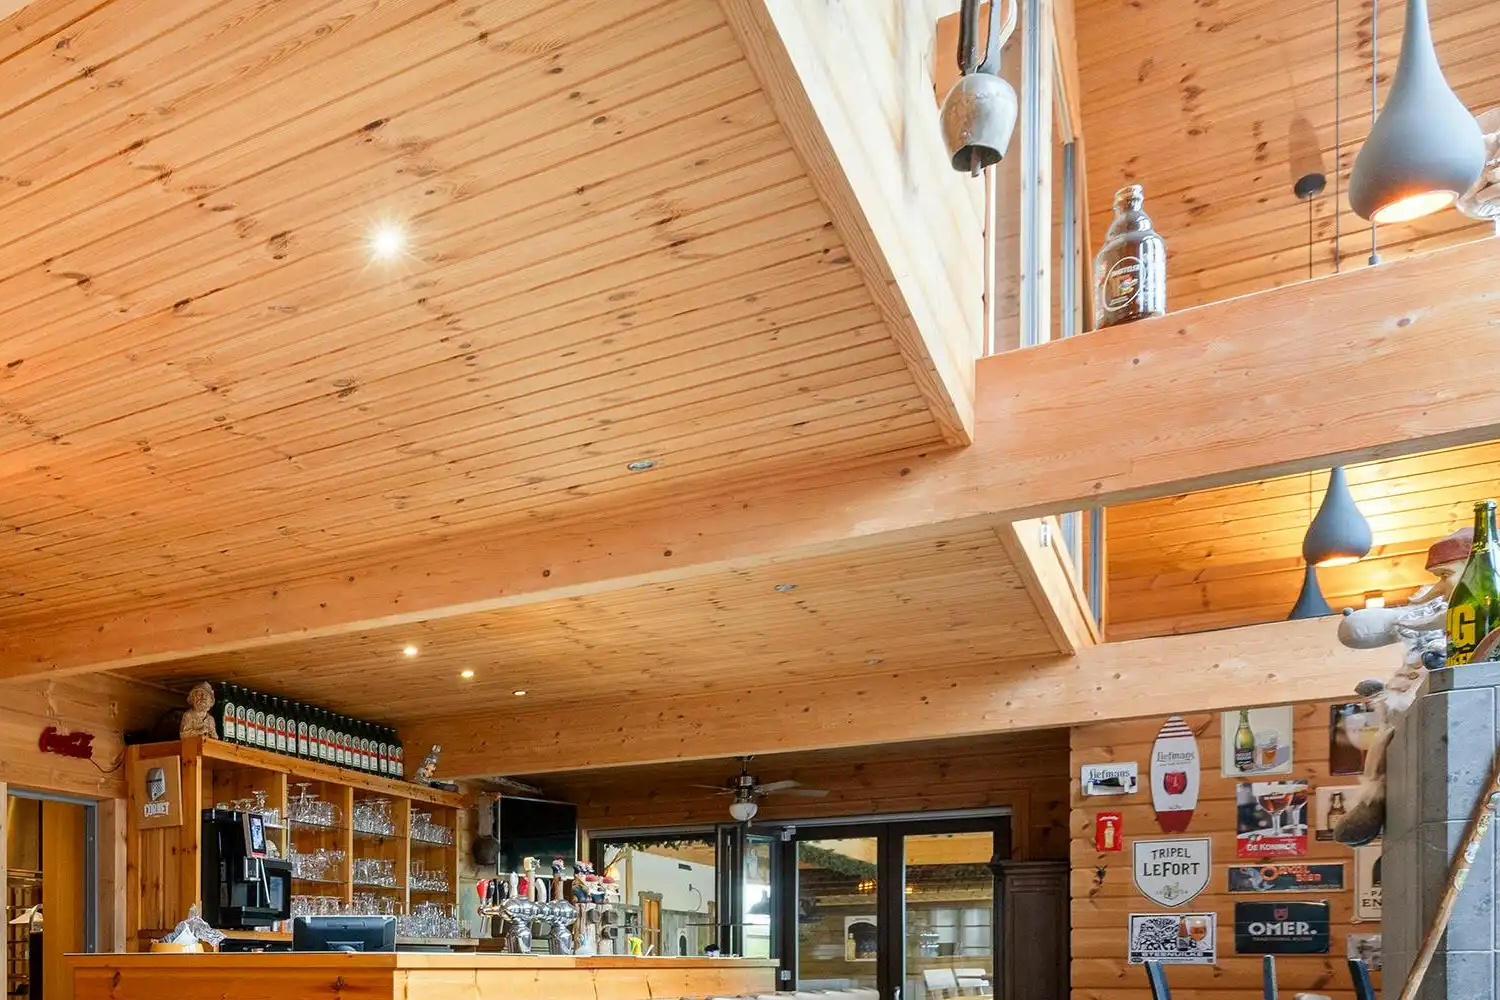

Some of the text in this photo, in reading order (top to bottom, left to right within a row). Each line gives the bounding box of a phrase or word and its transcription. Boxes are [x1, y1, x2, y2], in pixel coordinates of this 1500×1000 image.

[143, 801, 170, 817] CORNET
[1151, 847, 1191, 860] TRIPEL
[1362, 899, 1382, 907] EN
[1247, 921, 1317, 936] OMER.
